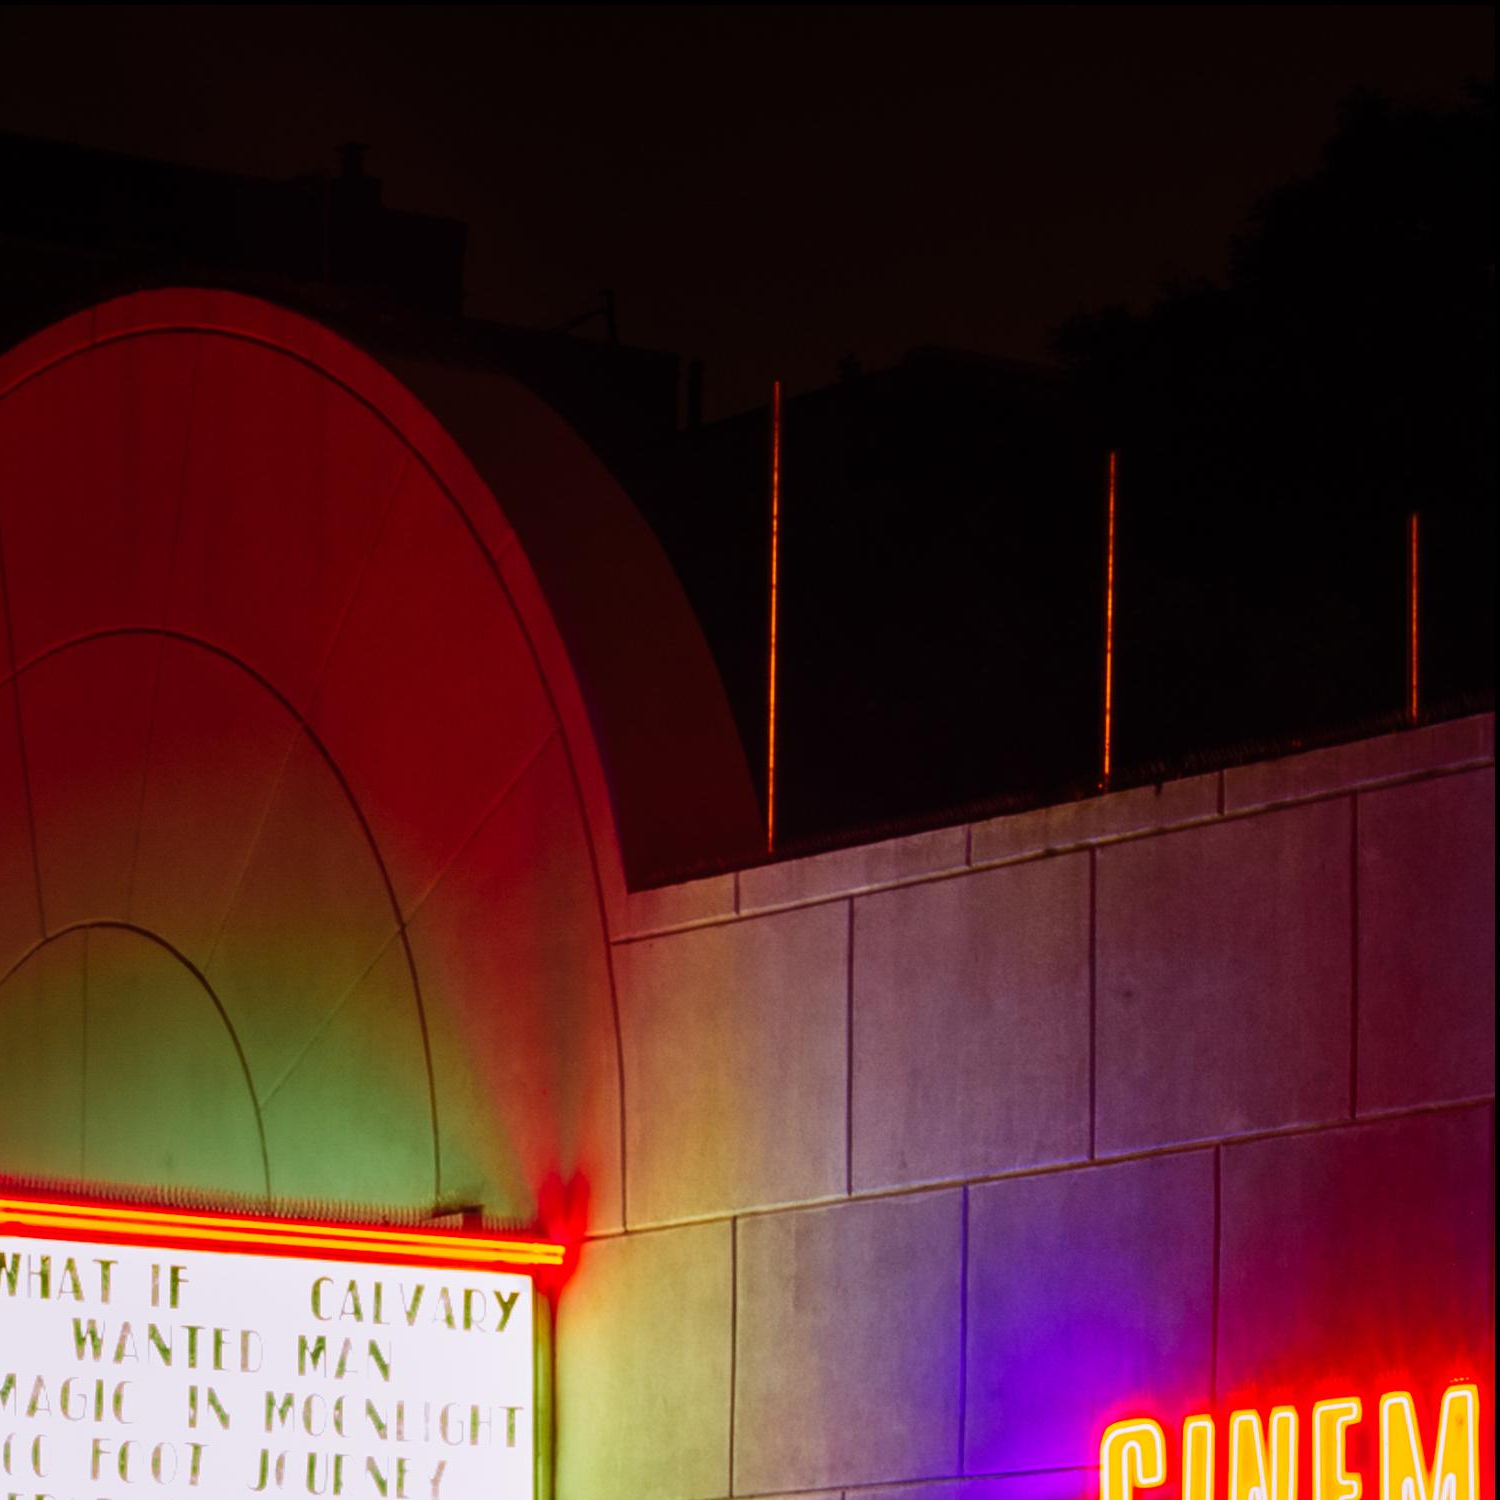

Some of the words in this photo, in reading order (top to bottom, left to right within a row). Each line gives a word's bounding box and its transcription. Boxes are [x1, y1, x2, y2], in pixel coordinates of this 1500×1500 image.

[152, 1263, 188, 1309] IF
[311, 1276, 520, 1333] CALVARY
[73, 1317, 262, 1373] WANTED
[298, 1334, 391, 1382] MAN
[188, 1385, 230, 1430] IN
[265, 1390, 524, 1448] MOONLIGHT
[91, 1437, 211, 1486] FOOT
[247, 1448, 447, 1500] JOURNEY
